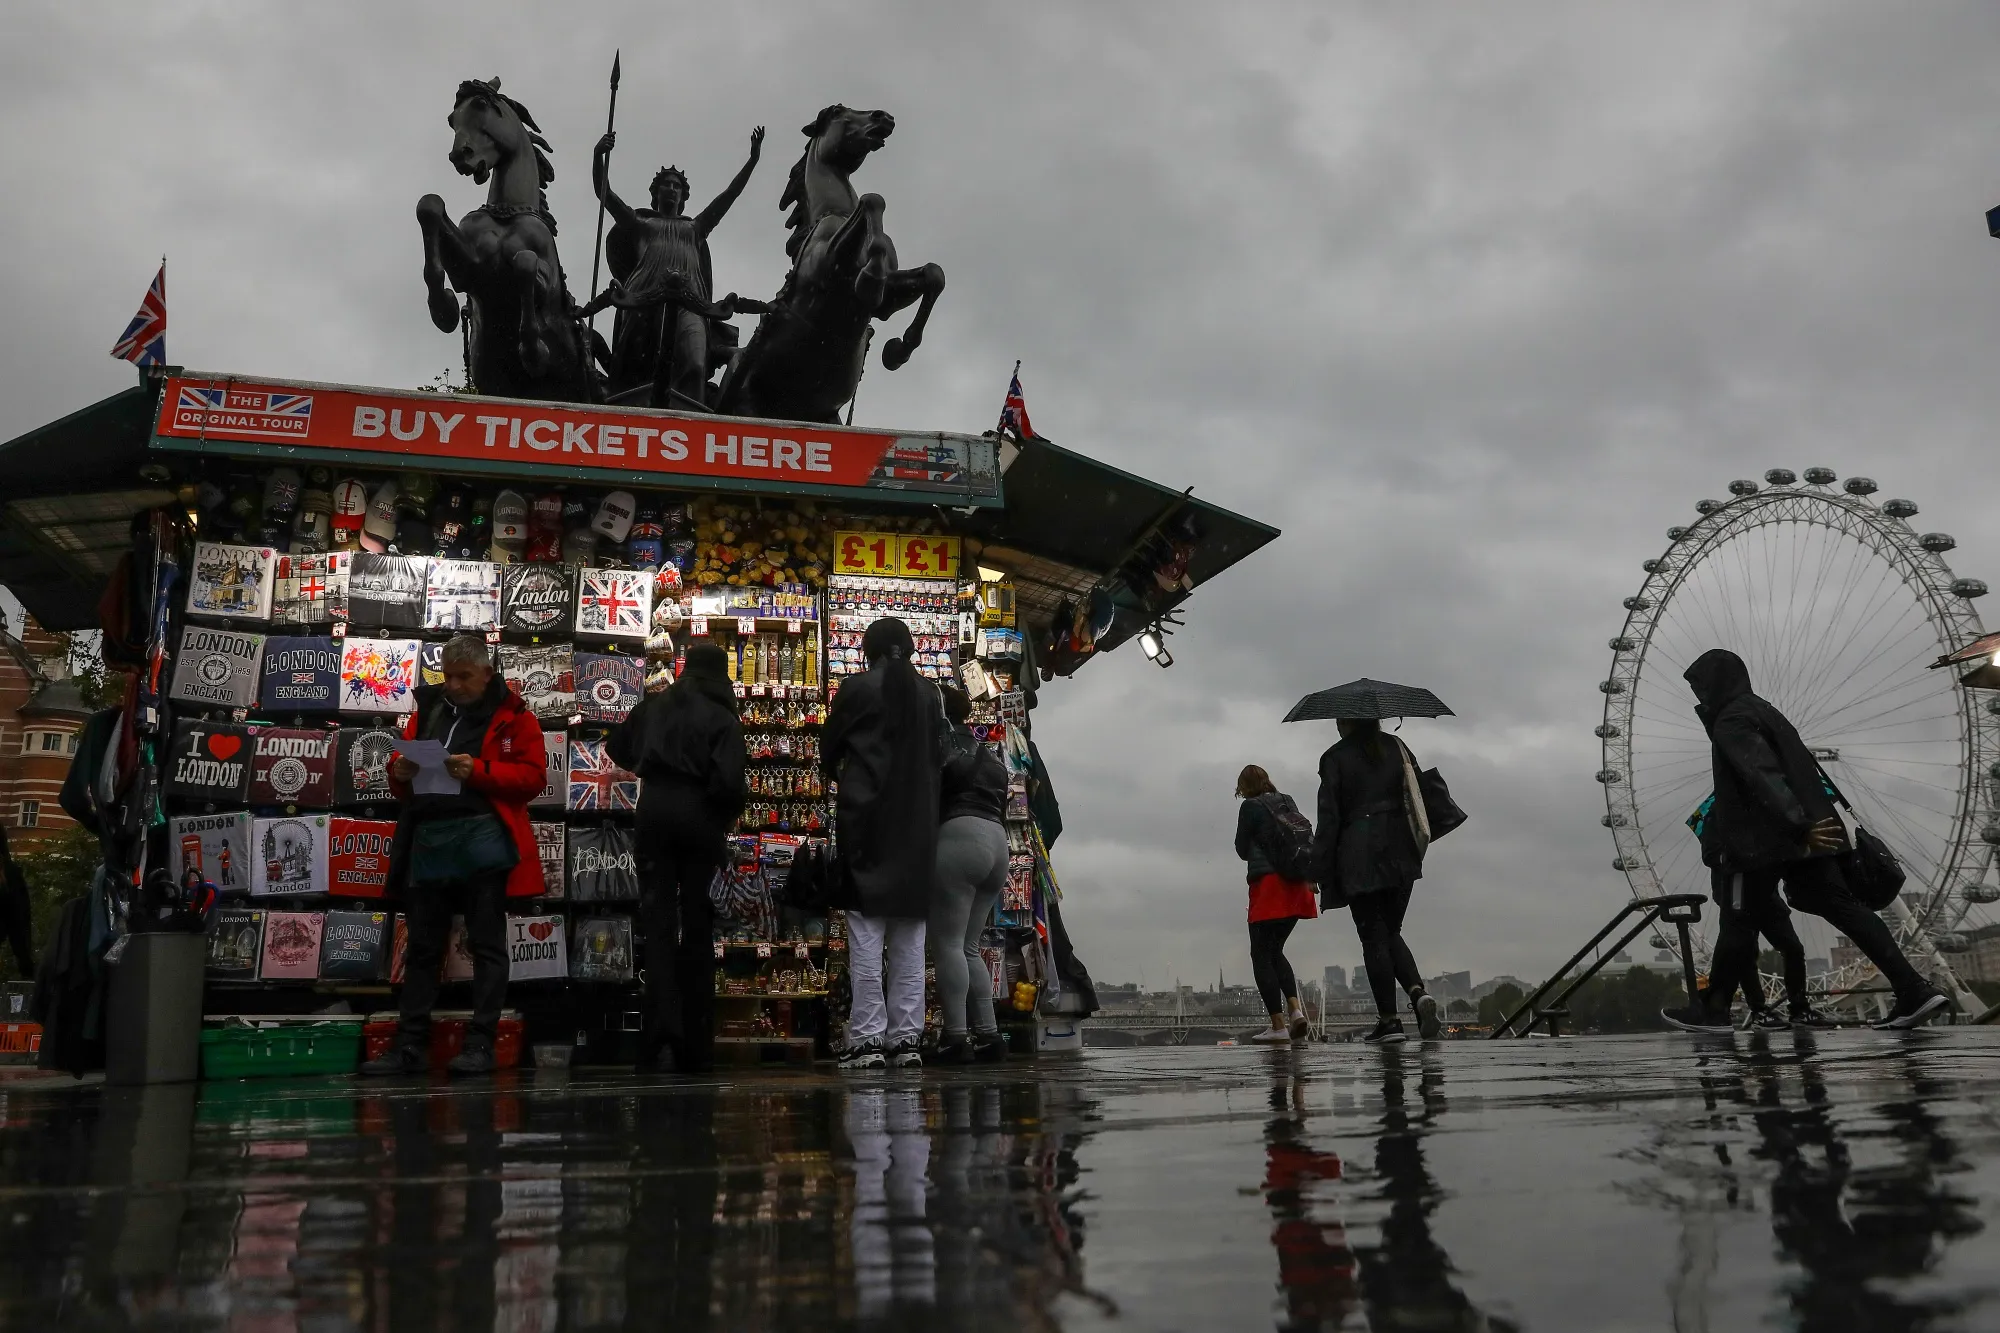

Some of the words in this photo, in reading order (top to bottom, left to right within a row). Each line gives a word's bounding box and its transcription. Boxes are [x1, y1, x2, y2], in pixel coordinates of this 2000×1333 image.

[230, 395, 262, 407] THE
[180, 412, 258, 427] ORIGINAL
[261, 418, 304, 430] TOUR
[352, 405, 466, 444] BUY
[475, 415, 689, 461] TICKETS
[705, 433, 832, 472] HERE
[841, 535, 886, 569] £1
[905, 539, 949, 572] £1
[583, 571, 631, 581] LONDON
[507, 566, 570, 607] London
[366, 592, 404, 602] LONDON
[608, 625, 645, 634] ENGLAND
[182, 632, 259, 661] LONDON
[180, 658, 195, 667] EST
[266, 650, 341, 675] LONDON
[344, 658, 412, 683] LONDON
[575, 659, 642, 692] LONDON
[183, 683, 234, 702] ENGLAND
[276, 686, 329, 699] ENGLAND
[520, 677, 558, 696] London
[187, 731, 205, 757] I
[255, 736, 329, 759] LONDON
[174, 758, 243, 788] LONDON
[255, 769, 269, 782] IX
[309, 772, 323, 785] IV
[356, 790, 396, 801] Londo
[178, 816, 235, 834] LONDON
[330, 833, 393, 858] LONDO
[572, 846, 638, 881] LONDON
[268, 881, 312, 893] London
[337, 869, 387, 886] ENGLAN
[325, 924, 381, 945] LONDON
[514, 923, 526, 943] I
[330, 949, 371, 962] ENGLAND
[511, 941, 558, 963] LONDON
